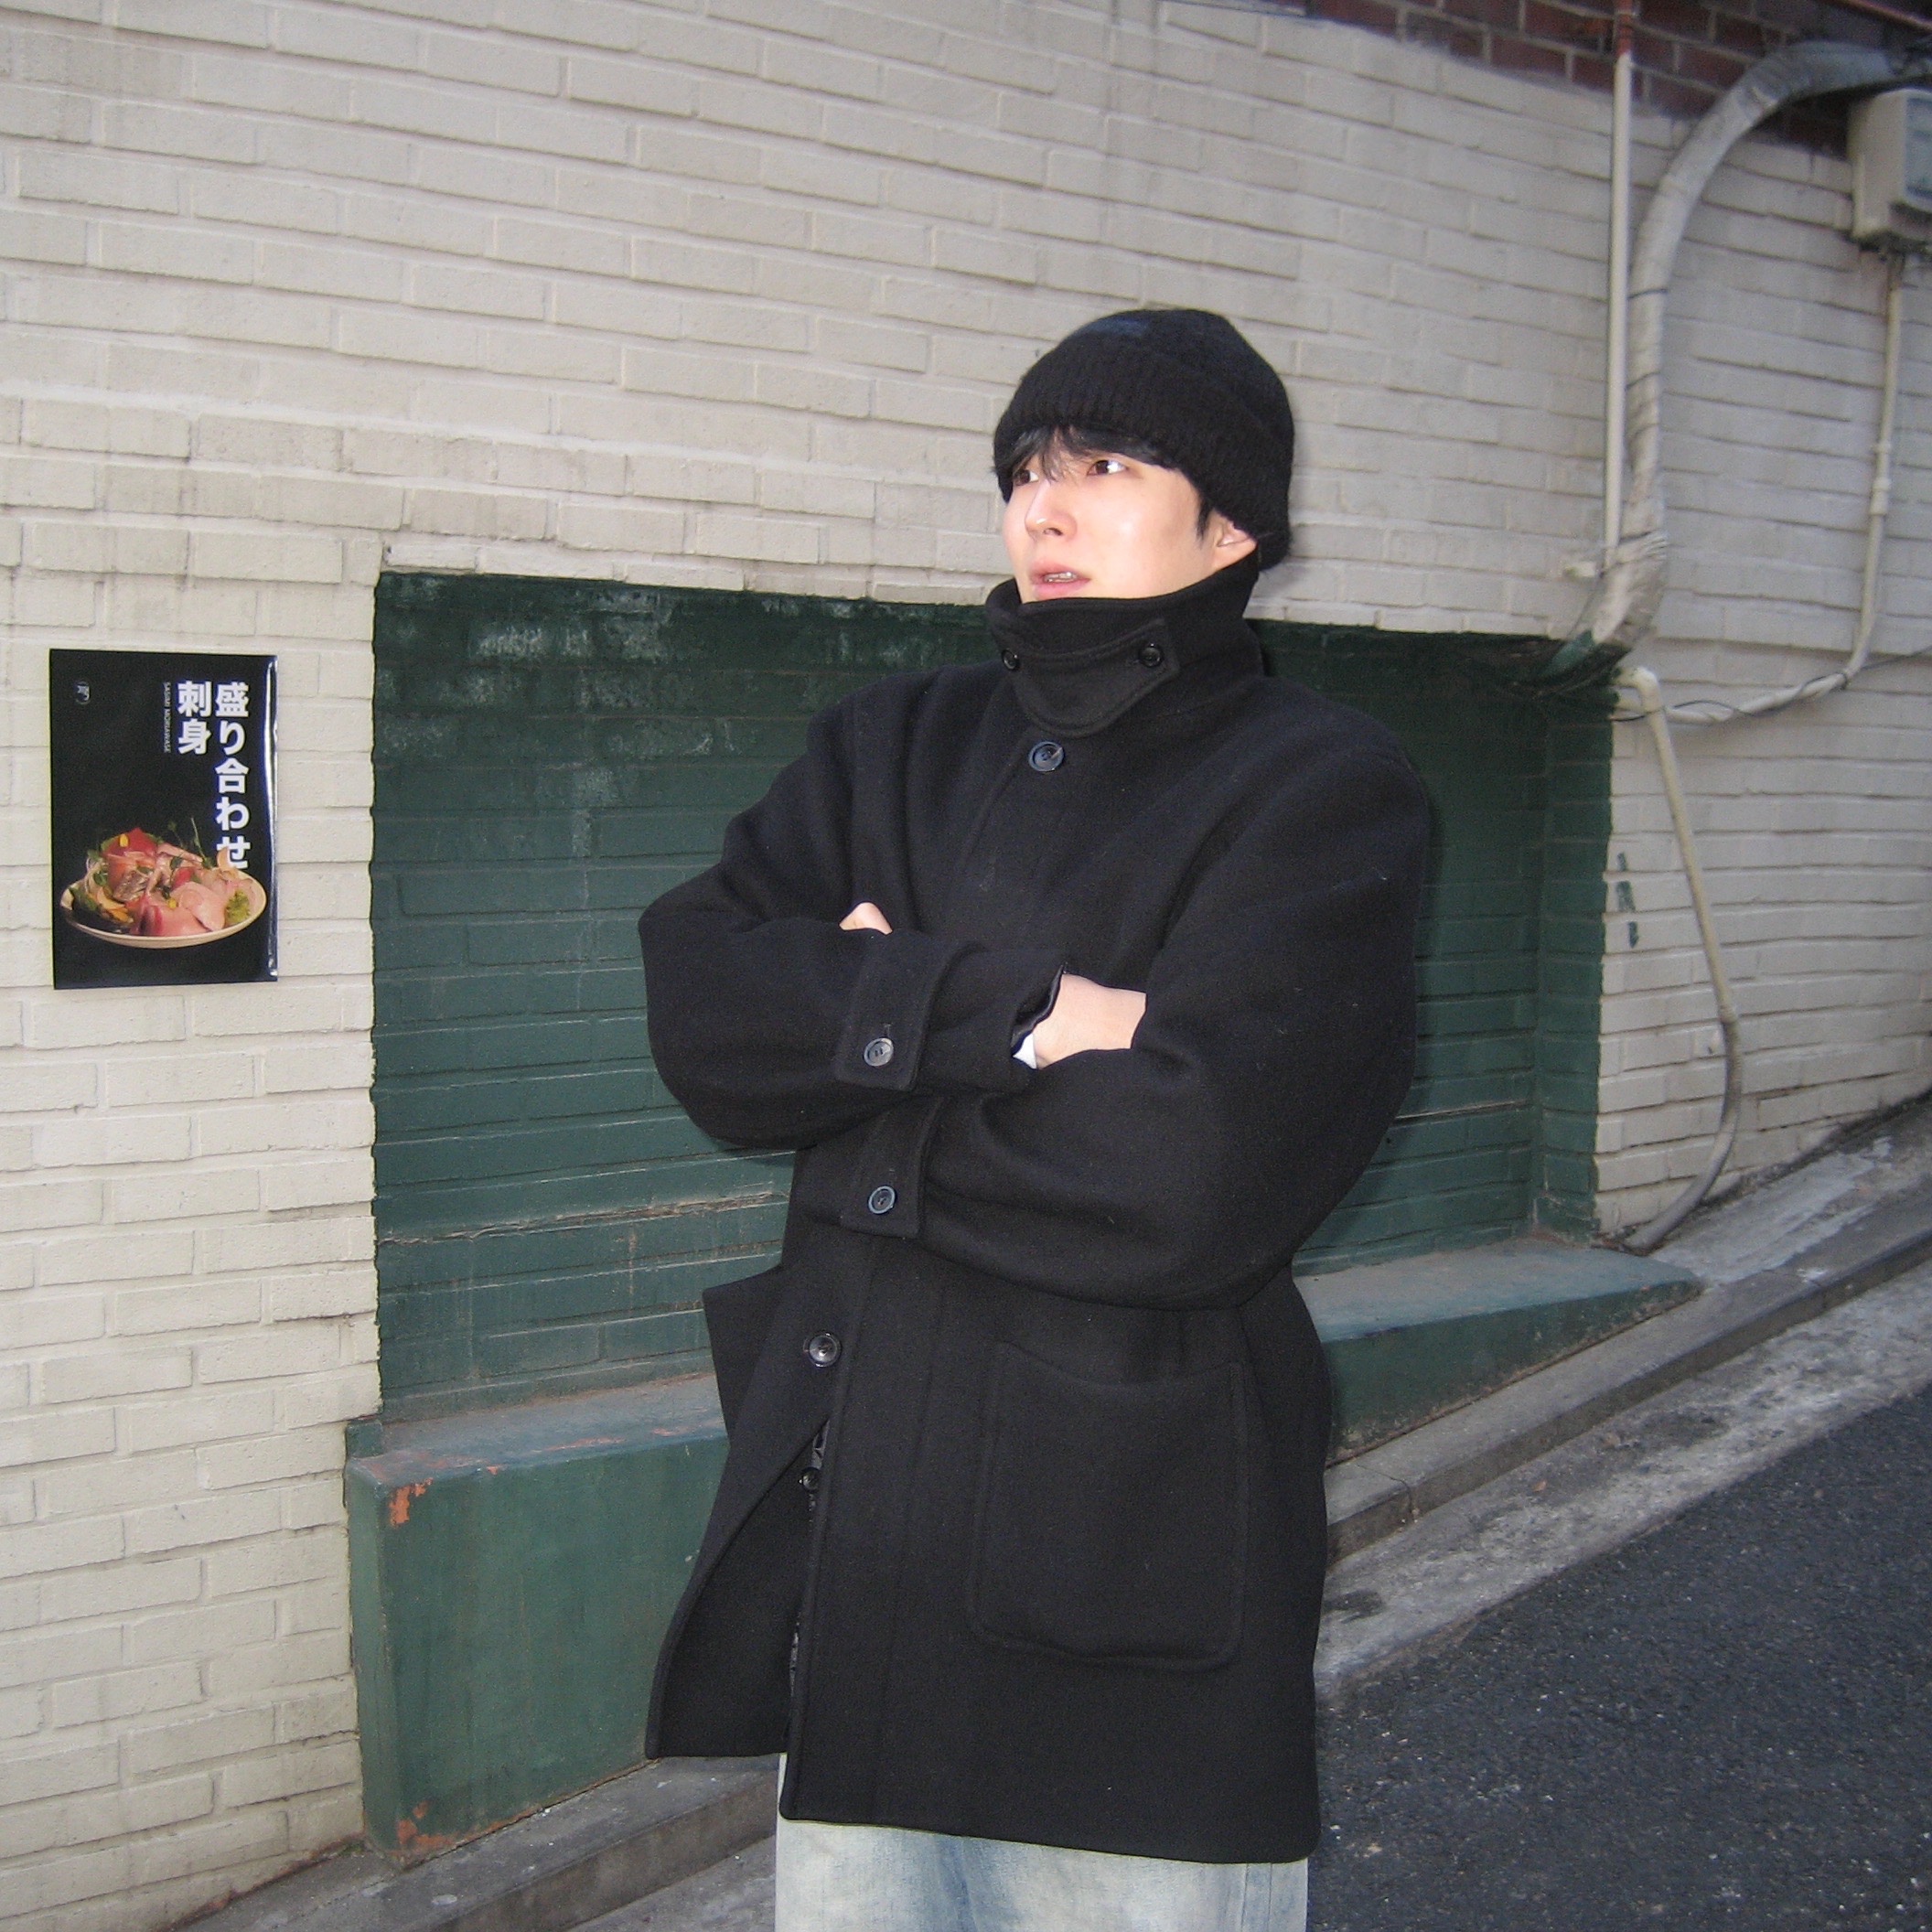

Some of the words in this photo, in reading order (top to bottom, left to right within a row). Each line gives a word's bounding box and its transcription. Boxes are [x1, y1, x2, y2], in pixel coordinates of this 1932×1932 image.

[177, 681, 211, 755] 刺身
[215, 682, 251, 869] 盛り合わせ
